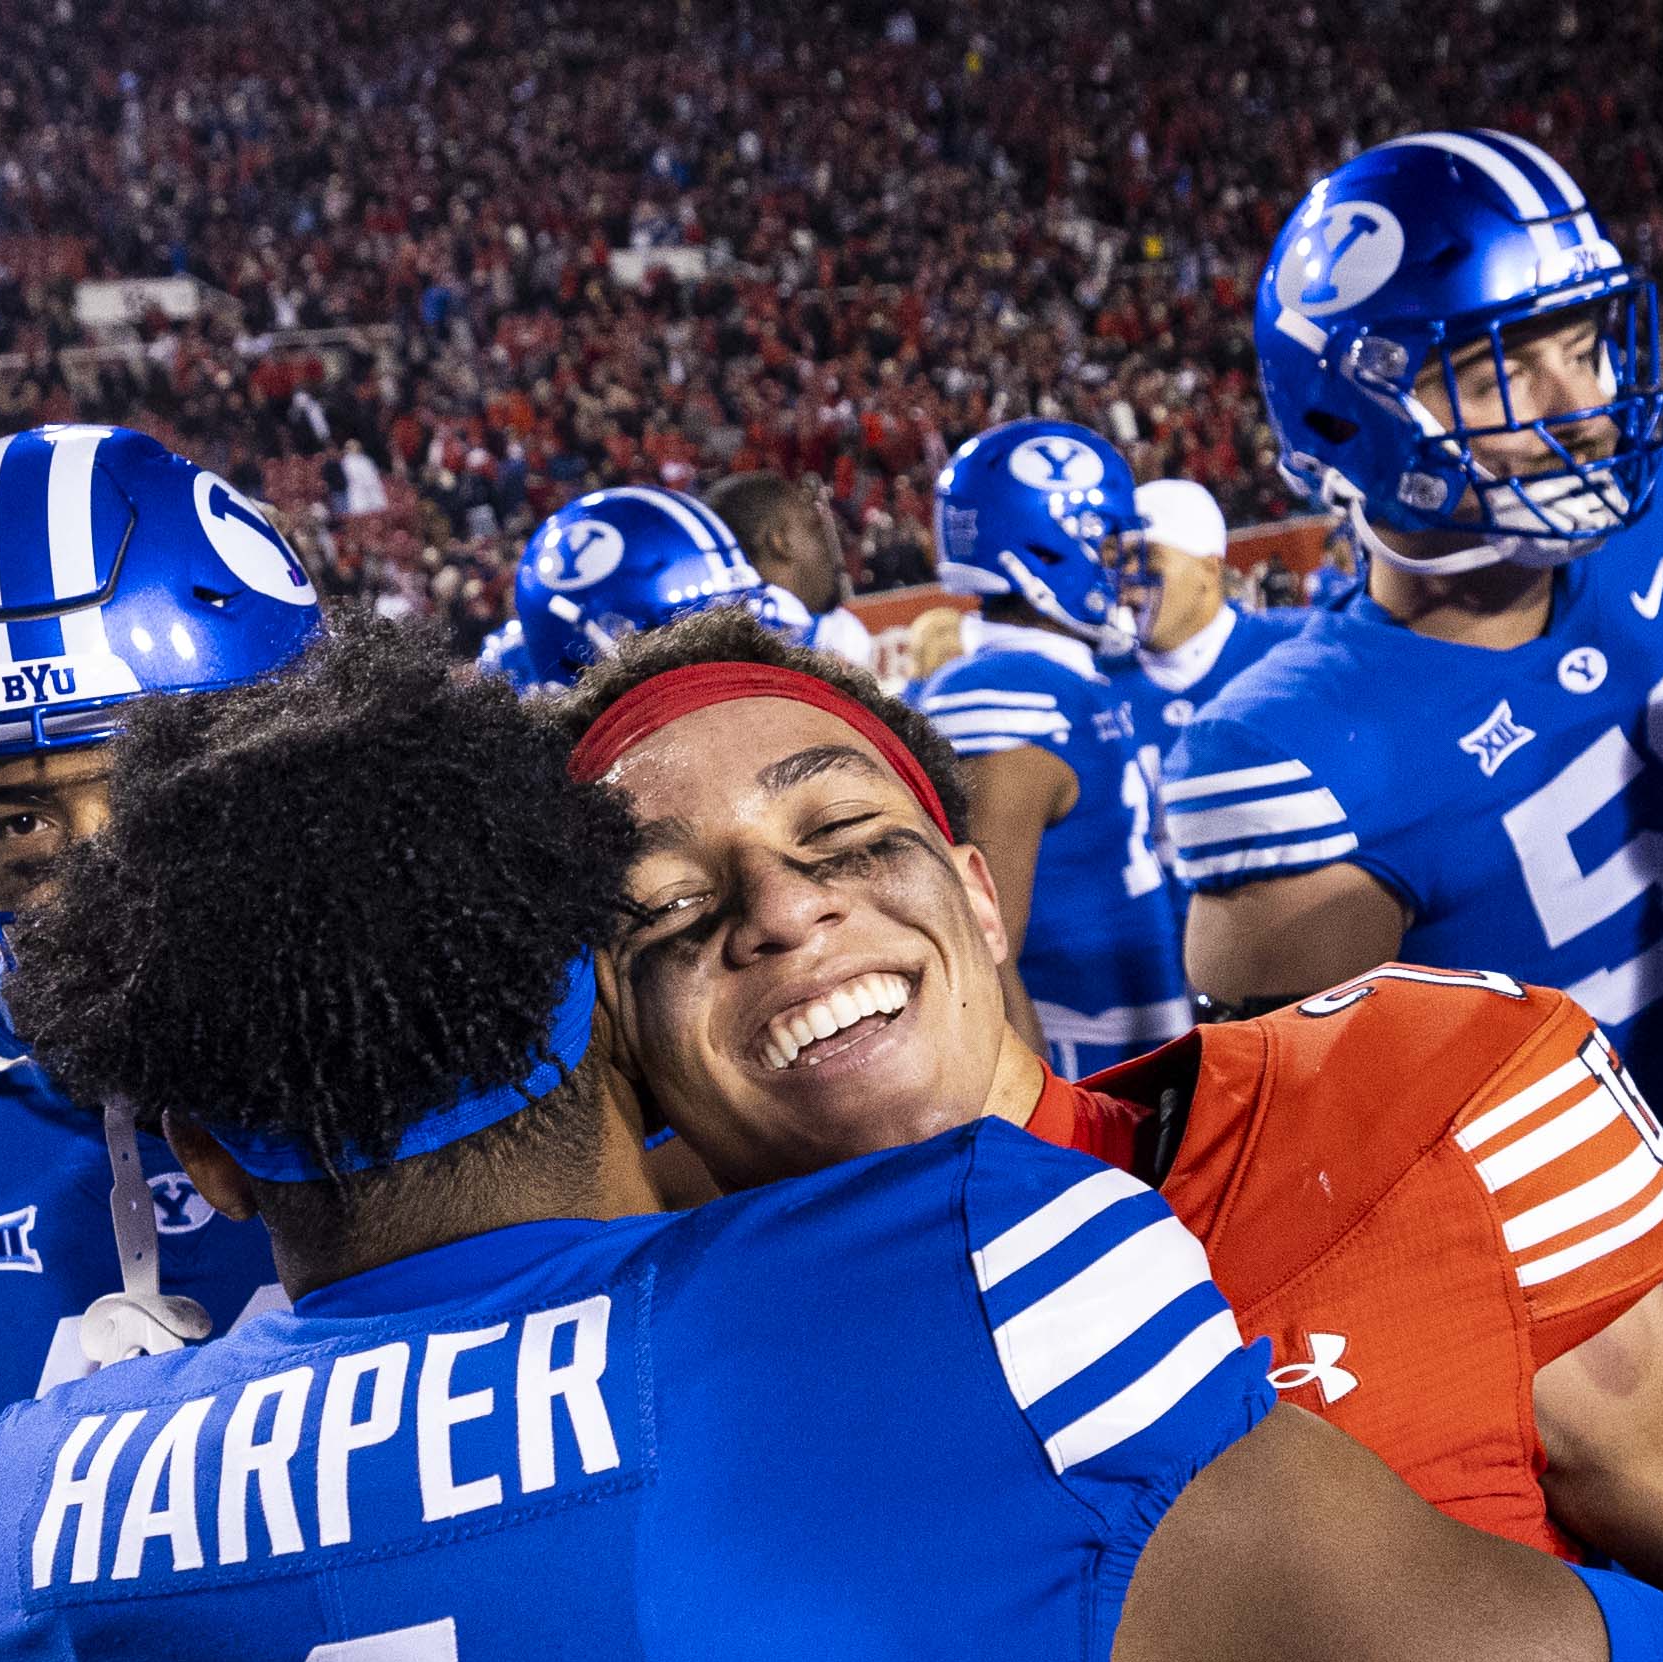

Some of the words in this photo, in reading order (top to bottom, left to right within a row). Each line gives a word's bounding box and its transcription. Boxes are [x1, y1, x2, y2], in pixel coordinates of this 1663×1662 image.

[1301, 213, 1381, 304] Y
[1034, 445, 1081, 481] Y
[1, 663, 76, 703] BYU
[1566, 654, 1597, 683] Y
[151, 1181, 201, 1226] Y
[31, 1294, 621, 1591] HARPER
